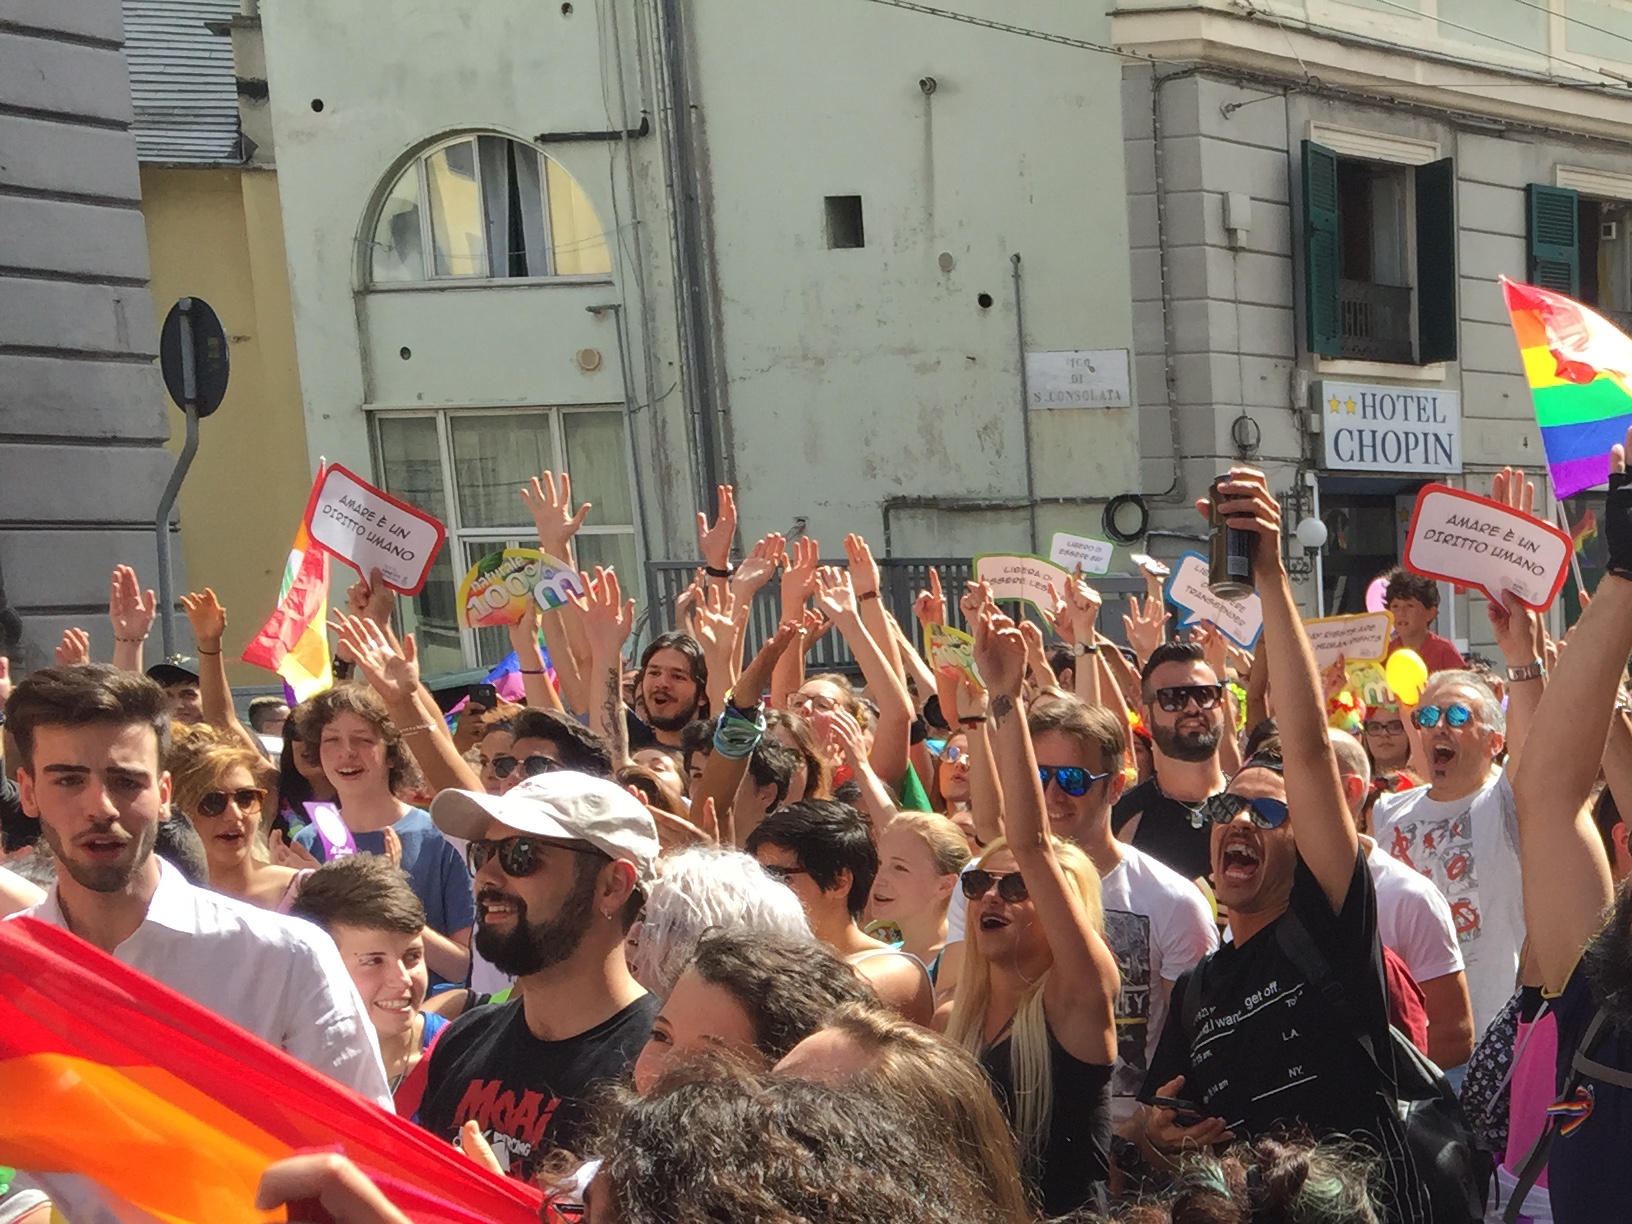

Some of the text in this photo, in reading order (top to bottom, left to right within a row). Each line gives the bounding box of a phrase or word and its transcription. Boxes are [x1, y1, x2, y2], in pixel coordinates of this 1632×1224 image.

[1071, 374, 1083, 384] DI
[1360, 392, 1446, 423] HOTEL
[1333, 428, 1453, 466] CHOPIN
[322, 504, 415, 561] DIRITTO UMANO
[339, 494, 411, 540] AMARE È UN
[1446, 514, 1541, 554] AMARE È UN
[1423, 529, 1488, 554] DIRITTO
[1490, 546, 1545, 577] UMANO
[986, 576, 1026, 586] SSERE
[1185, 585, 1246, 626] TRANSGENDER
[1310, 632, 1322, 640] AY
[1244, 990, 1263, 1010] get
